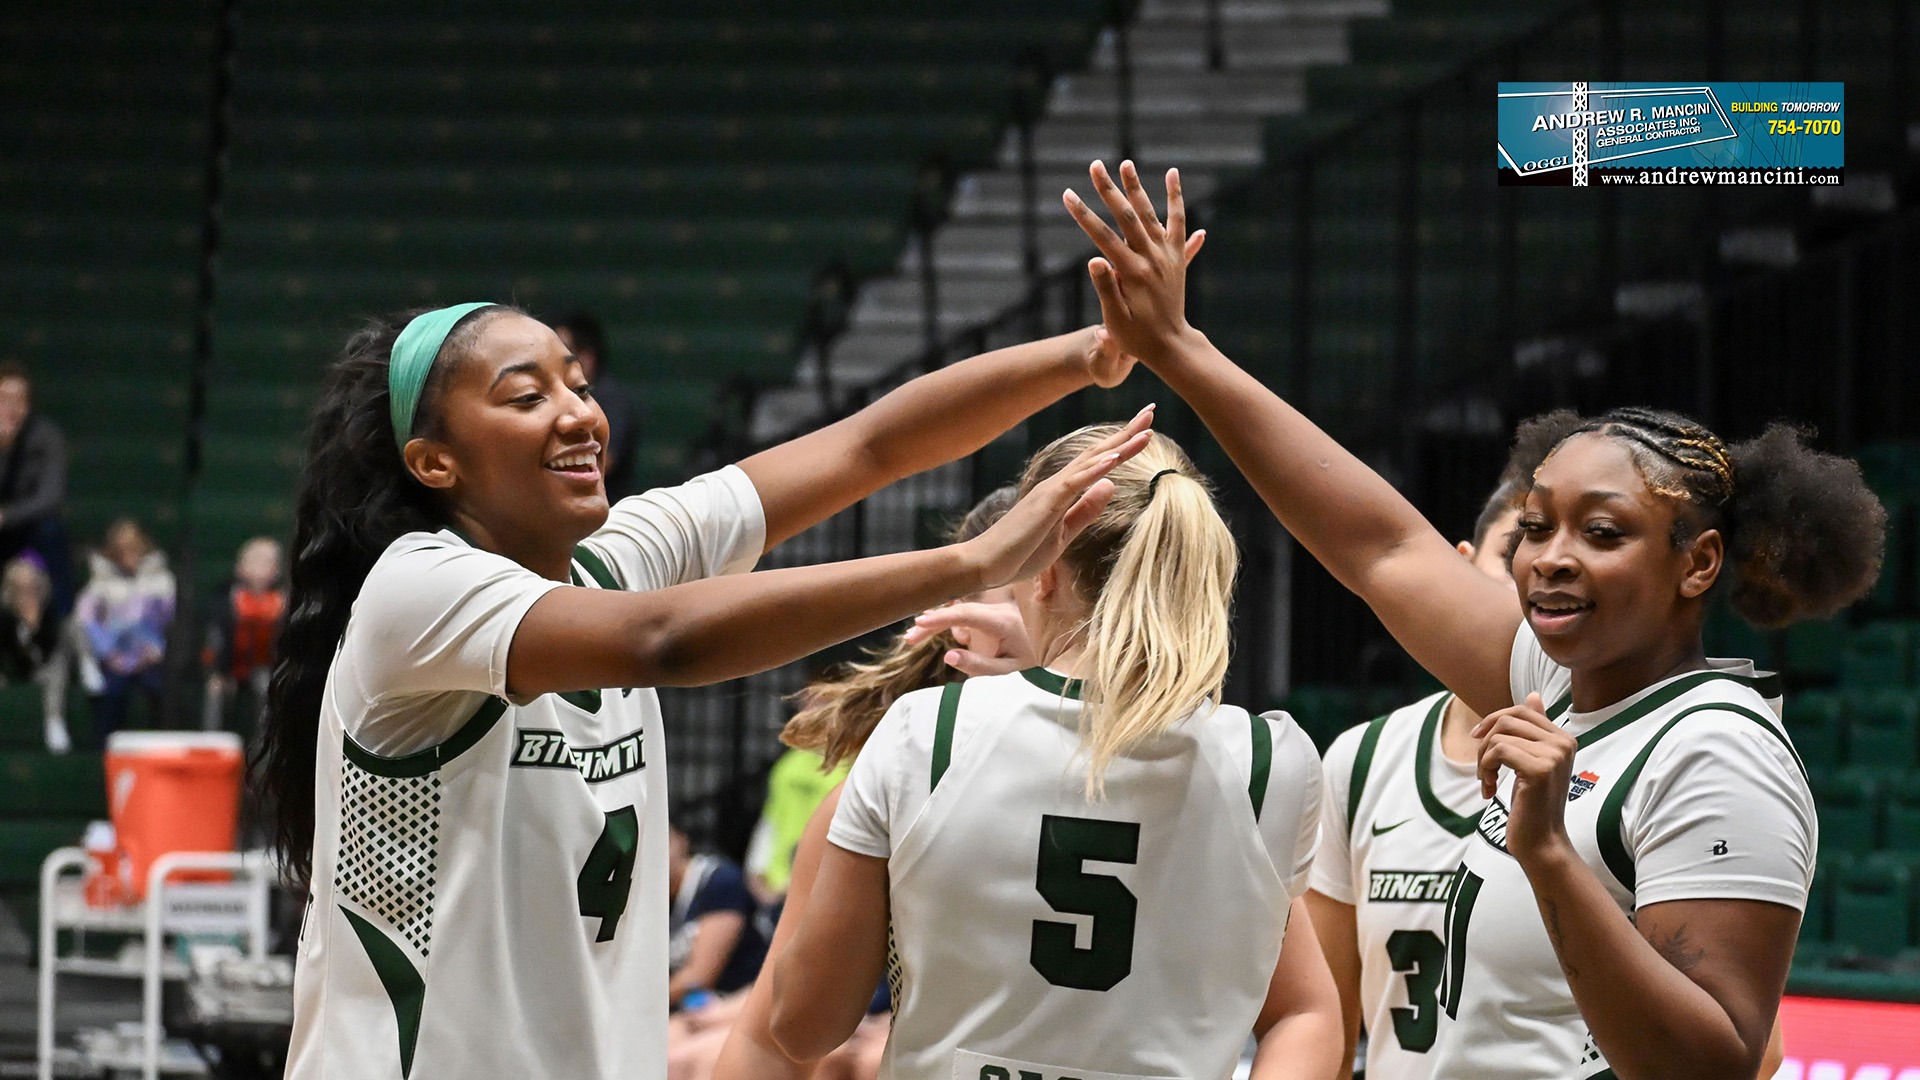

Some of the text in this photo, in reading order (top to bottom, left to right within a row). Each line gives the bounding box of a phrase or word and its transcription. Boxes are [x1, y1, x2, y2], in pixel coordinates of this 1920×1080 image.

[577, 804, 639, 943] 4
[1030, 814, 1141, 992] 5
[1369, 873, 1456, 900] BINGH
[1386, 929, 1446, 1054] 3
